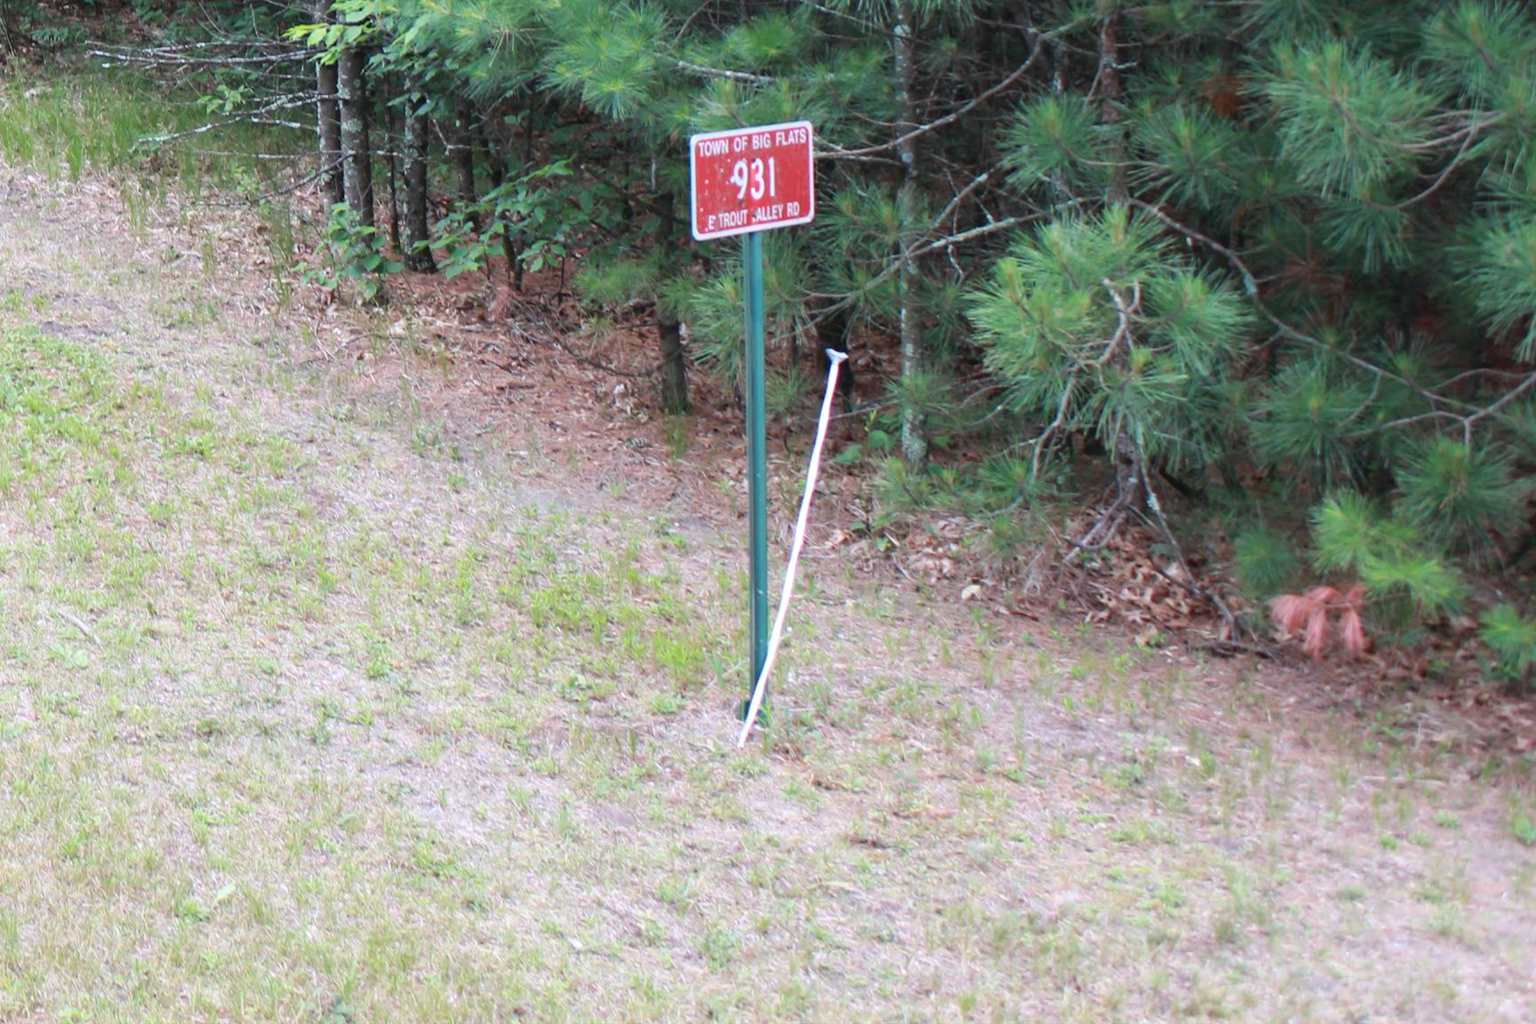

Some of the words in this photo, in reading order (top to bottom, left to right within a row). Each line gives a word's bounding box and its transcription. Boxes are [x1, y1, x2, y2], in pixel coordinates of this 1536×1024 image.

[698, 138, 730, 158] TOWN
[733, 136, 748, 153] OF
[752, 133, 771, 150] BIG
[775, 128, 807, 147] FLATS
[730, 156, 776, 200] 931
[718, 209, 749, 228] TROUT
[787, 201, 800, 217] RD
